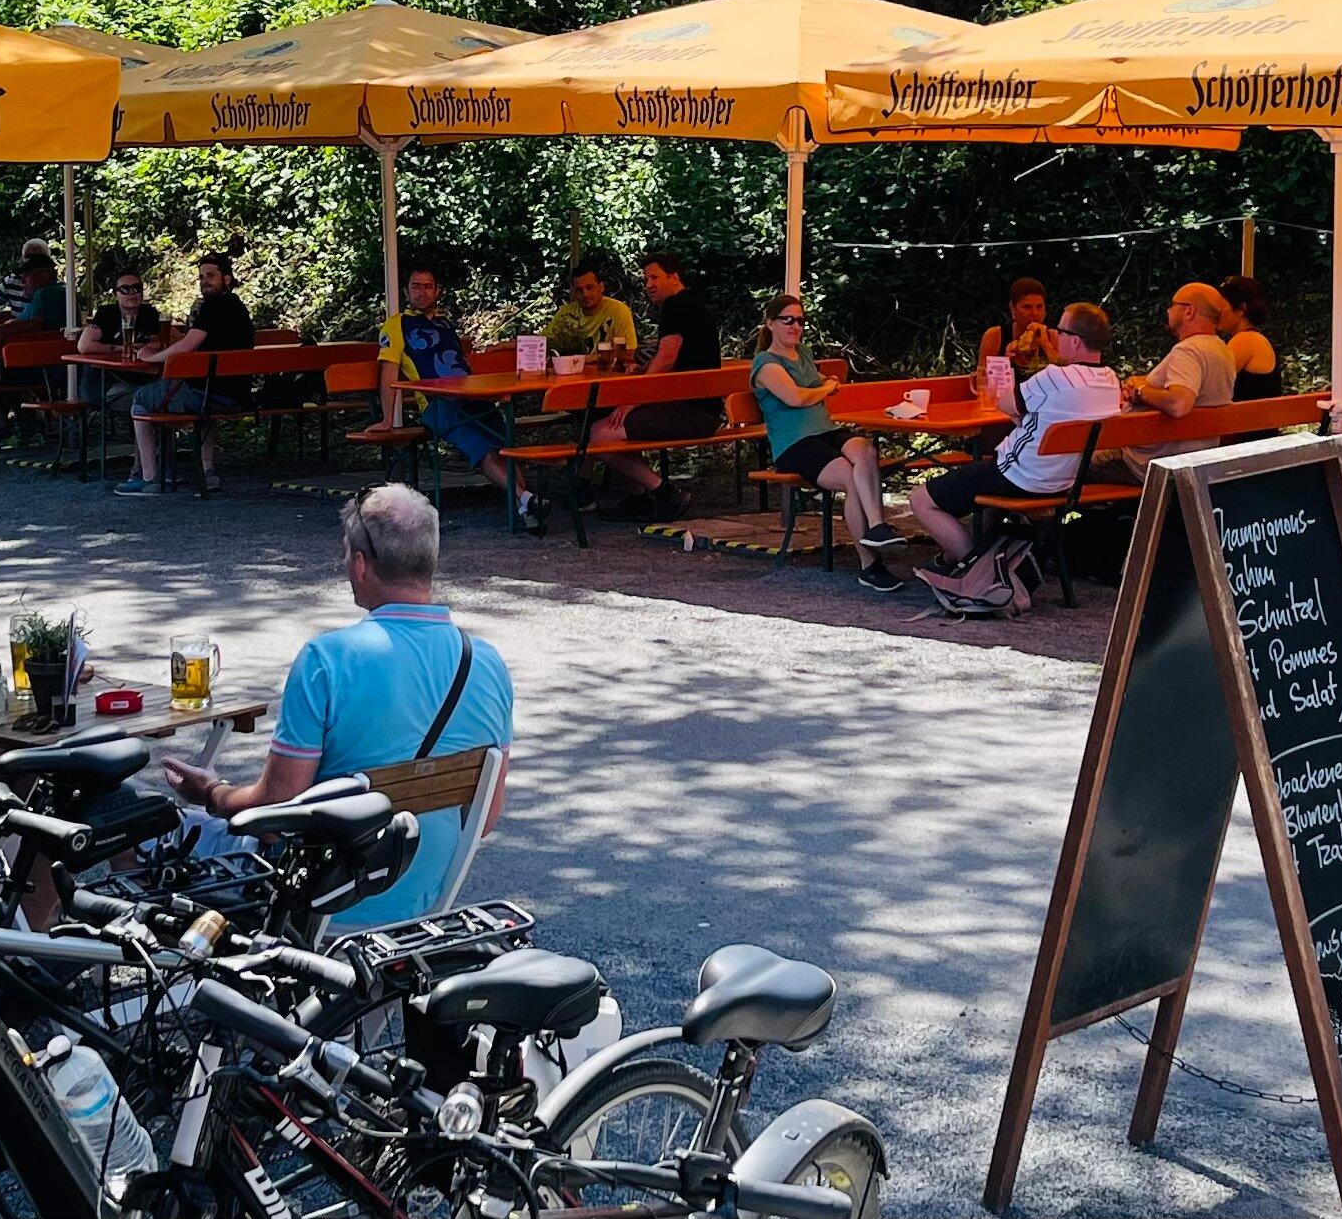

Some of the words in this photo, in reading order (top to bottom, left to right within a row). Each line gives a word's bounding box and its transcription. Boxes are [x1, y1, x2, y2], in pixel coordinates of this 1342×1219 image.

[210, 92, 312, 134] Schöfferhofer
[407, 84, 512, 130] Schöfferhofer
[614, 82, 736, 130] Schöfferhofer
[881, 68, 1039, 119] Schöfferhofer
[1237, 577, 1328, 640] Schnitzel
[1268, 638, 1338, 680] Pommes
[1289, 670, 1338, 713] Salat
